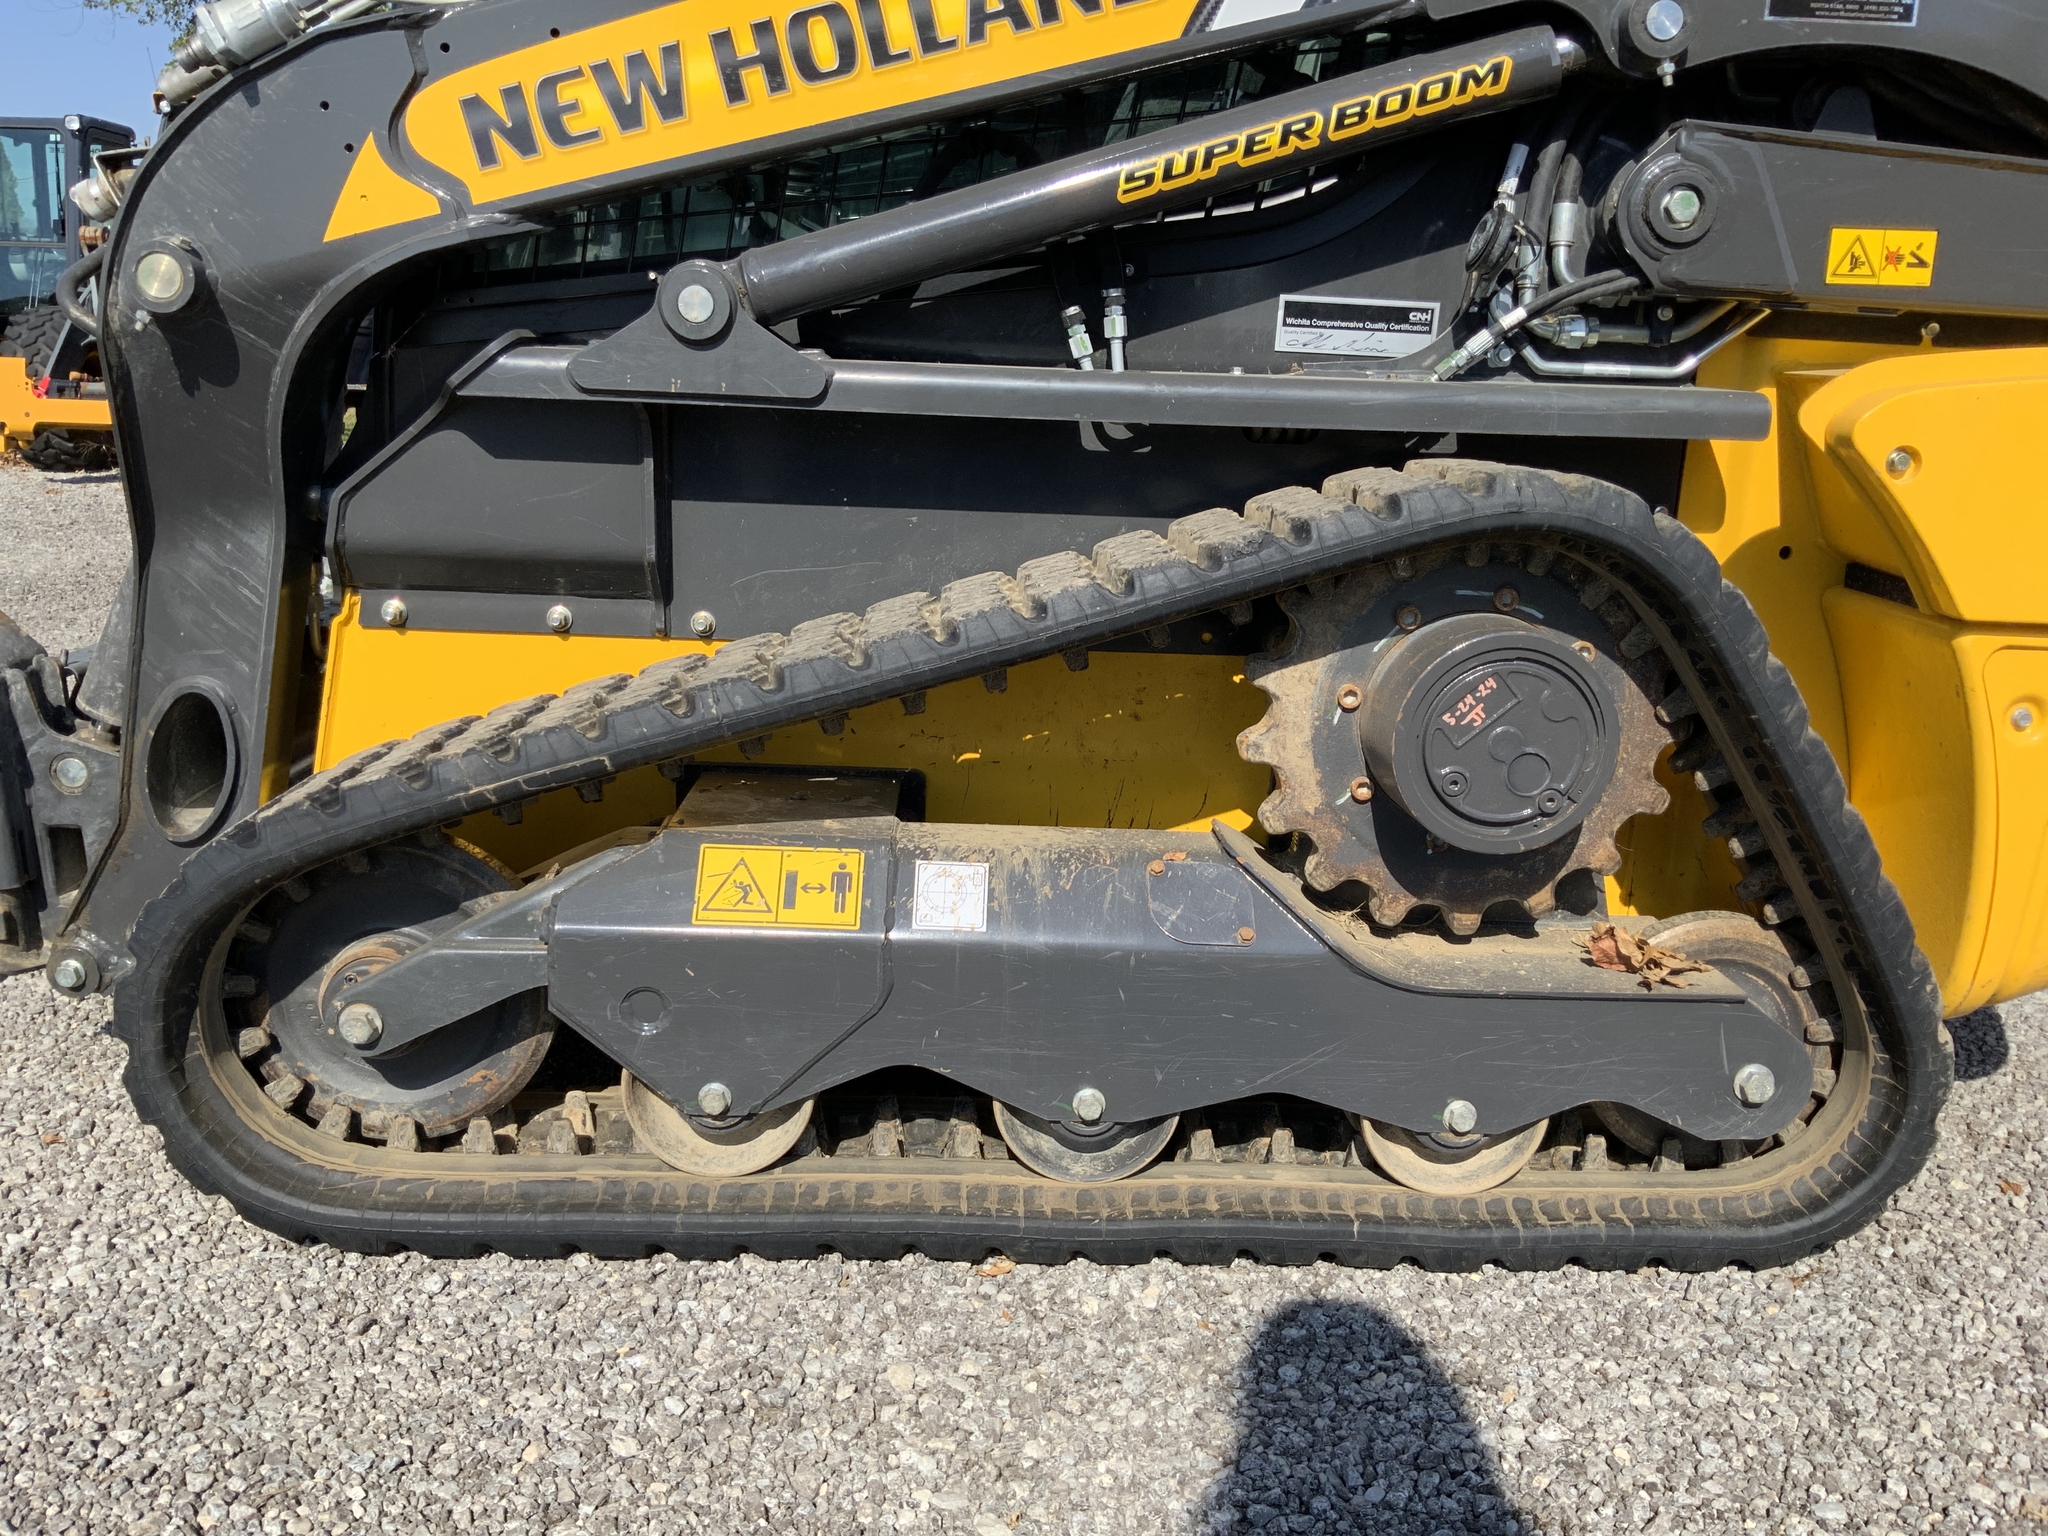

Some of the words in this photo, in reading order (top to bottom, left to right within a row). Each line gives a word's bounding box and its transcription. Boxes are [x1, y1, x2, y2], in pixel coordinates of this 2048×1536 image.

[458, 40, 689, 172] NEW
[709, 0, 1146, 108] HOLLA
[1118, 111, 1321, 202] SUPER
[1330, 56, 1511, 140] BOOM
[1285, 317, 1311, 326] Wichita
[1311, 318, 1364, 329] Comprehensive
[1364, 321, 1389, 331] Quality
[1389, 322, 1430, 332] Certification
[1442, 677, 1497, 726] 5-24-24
